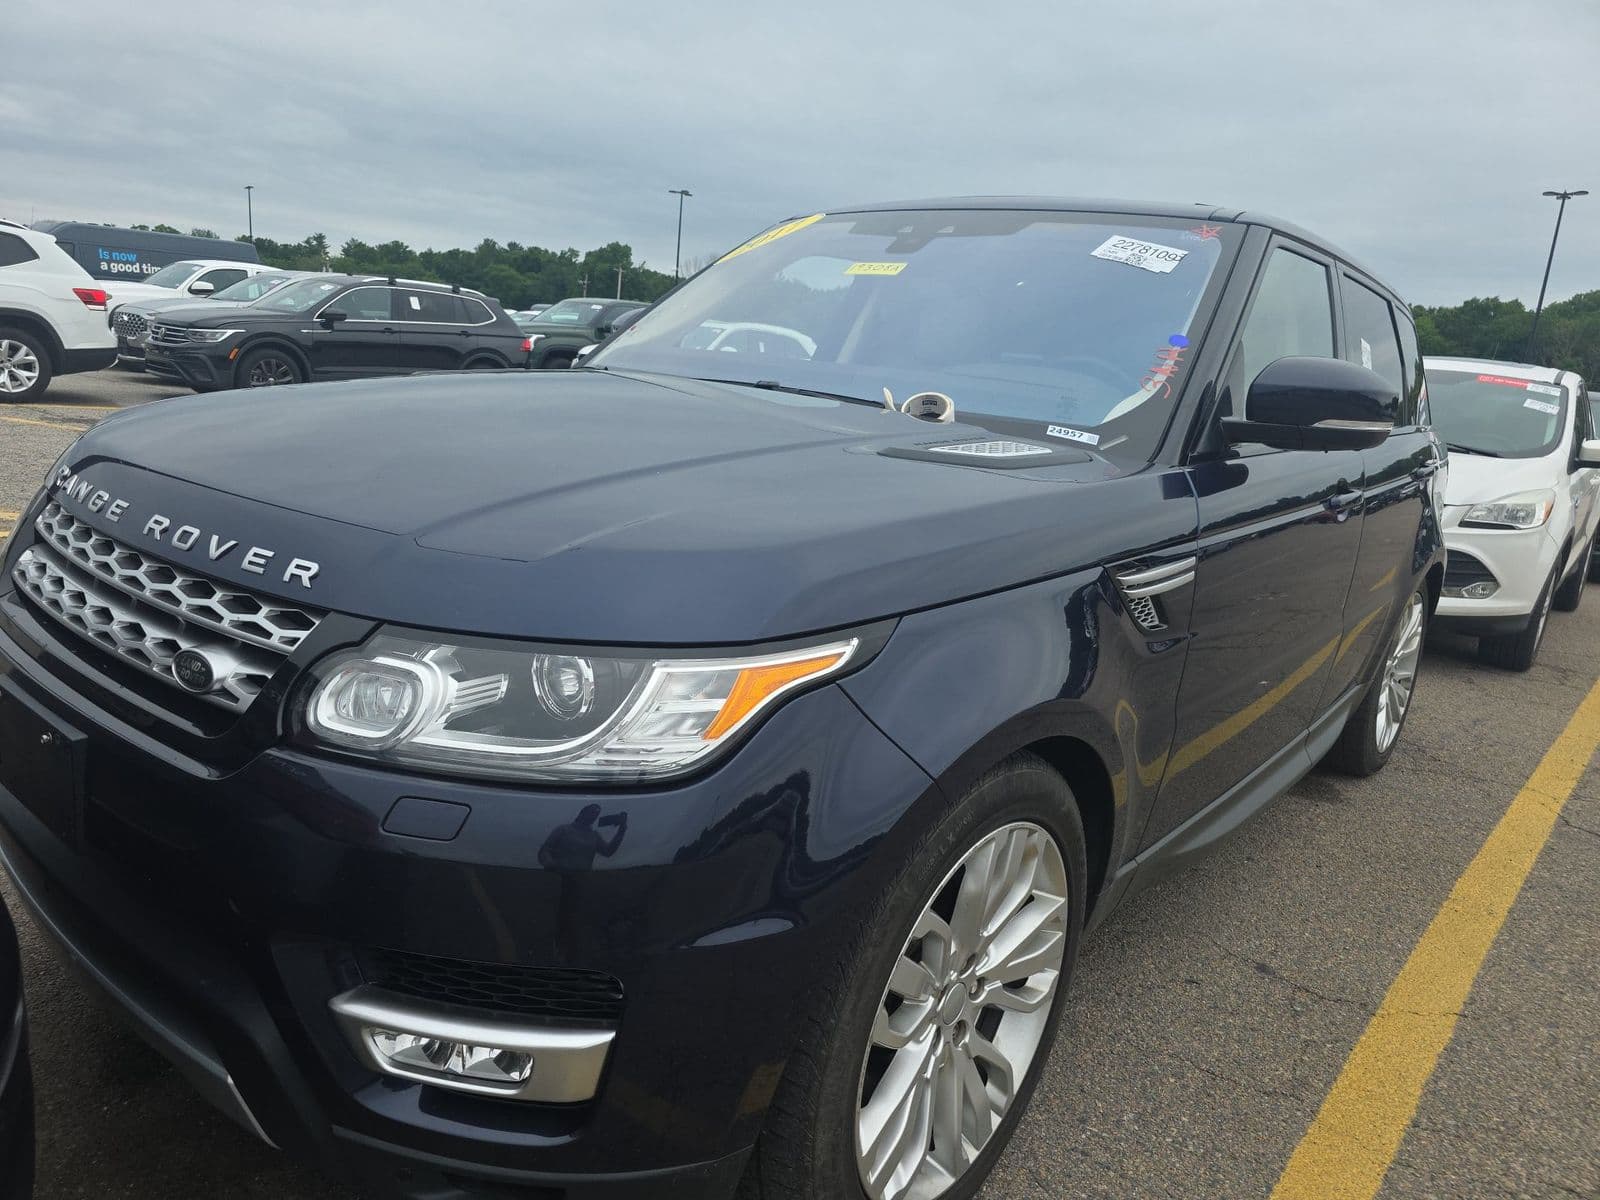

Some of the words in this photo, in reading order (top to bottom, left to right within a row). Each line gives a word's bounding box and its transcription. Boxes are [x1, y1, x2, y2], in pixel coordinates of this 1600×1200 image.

[99, 248, 110, 260] Is
[112, 251, 137, 262] now
[100, 261, 109, 271] a
[110, 262, 141, 274] good
[142, 263, 162, 274] tim
[1049, 426, 1083, 439] 24957
[56, 464, 131, 523] RANGE
[142, 513, 321, 590] ROVER
